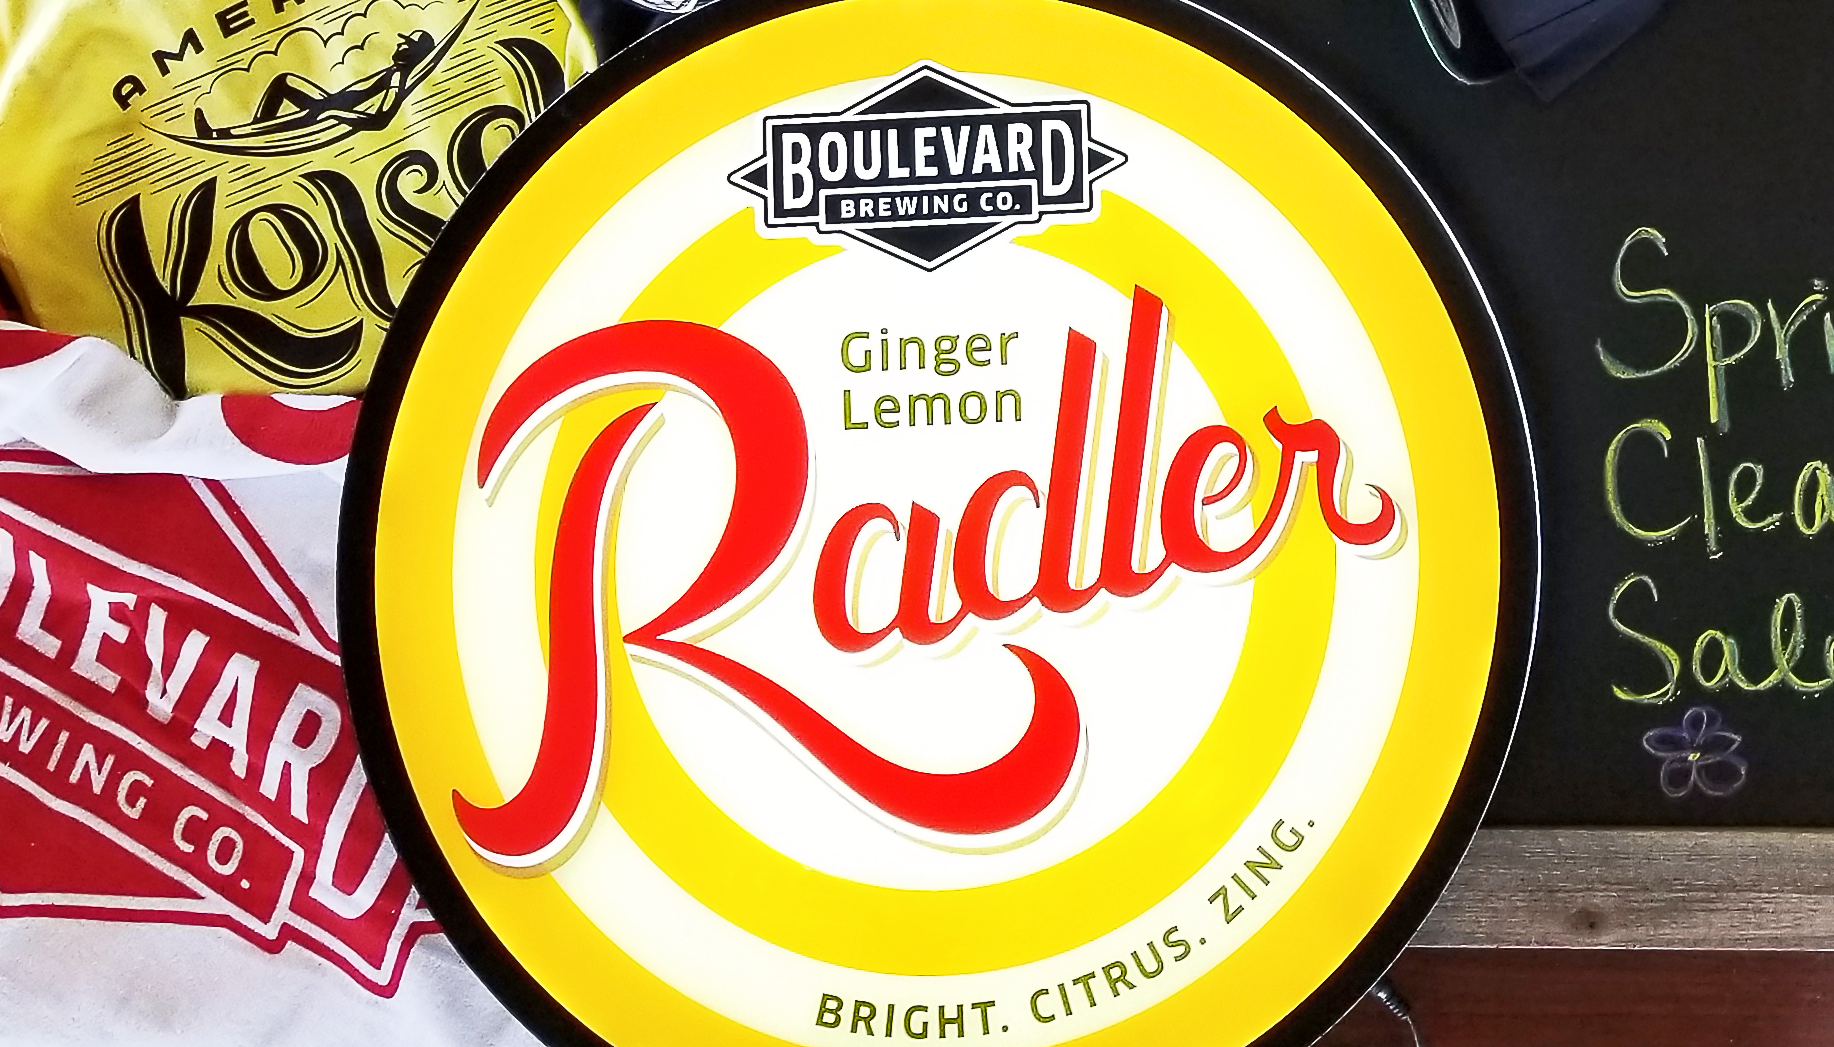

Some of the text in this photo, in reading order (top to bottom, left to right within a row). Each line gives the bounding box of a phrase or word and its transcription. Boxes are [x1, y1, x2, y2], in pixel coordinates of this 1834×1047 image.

[781, 118, 1076, 210] BOULEVARD
[840, 190, 1021, 220] BREWING CO.
[840, 324, 1018, 376] Ginger
[841, 382, 1023, 431] Lemon
[450, 283, 1402, 867] Radler
[0, 527, 400, 919] LEVARD
[172, 805, 252, 889] CO.
[816, 817, 1315, 1040] BRIGHT. CITRUS. ZING.
